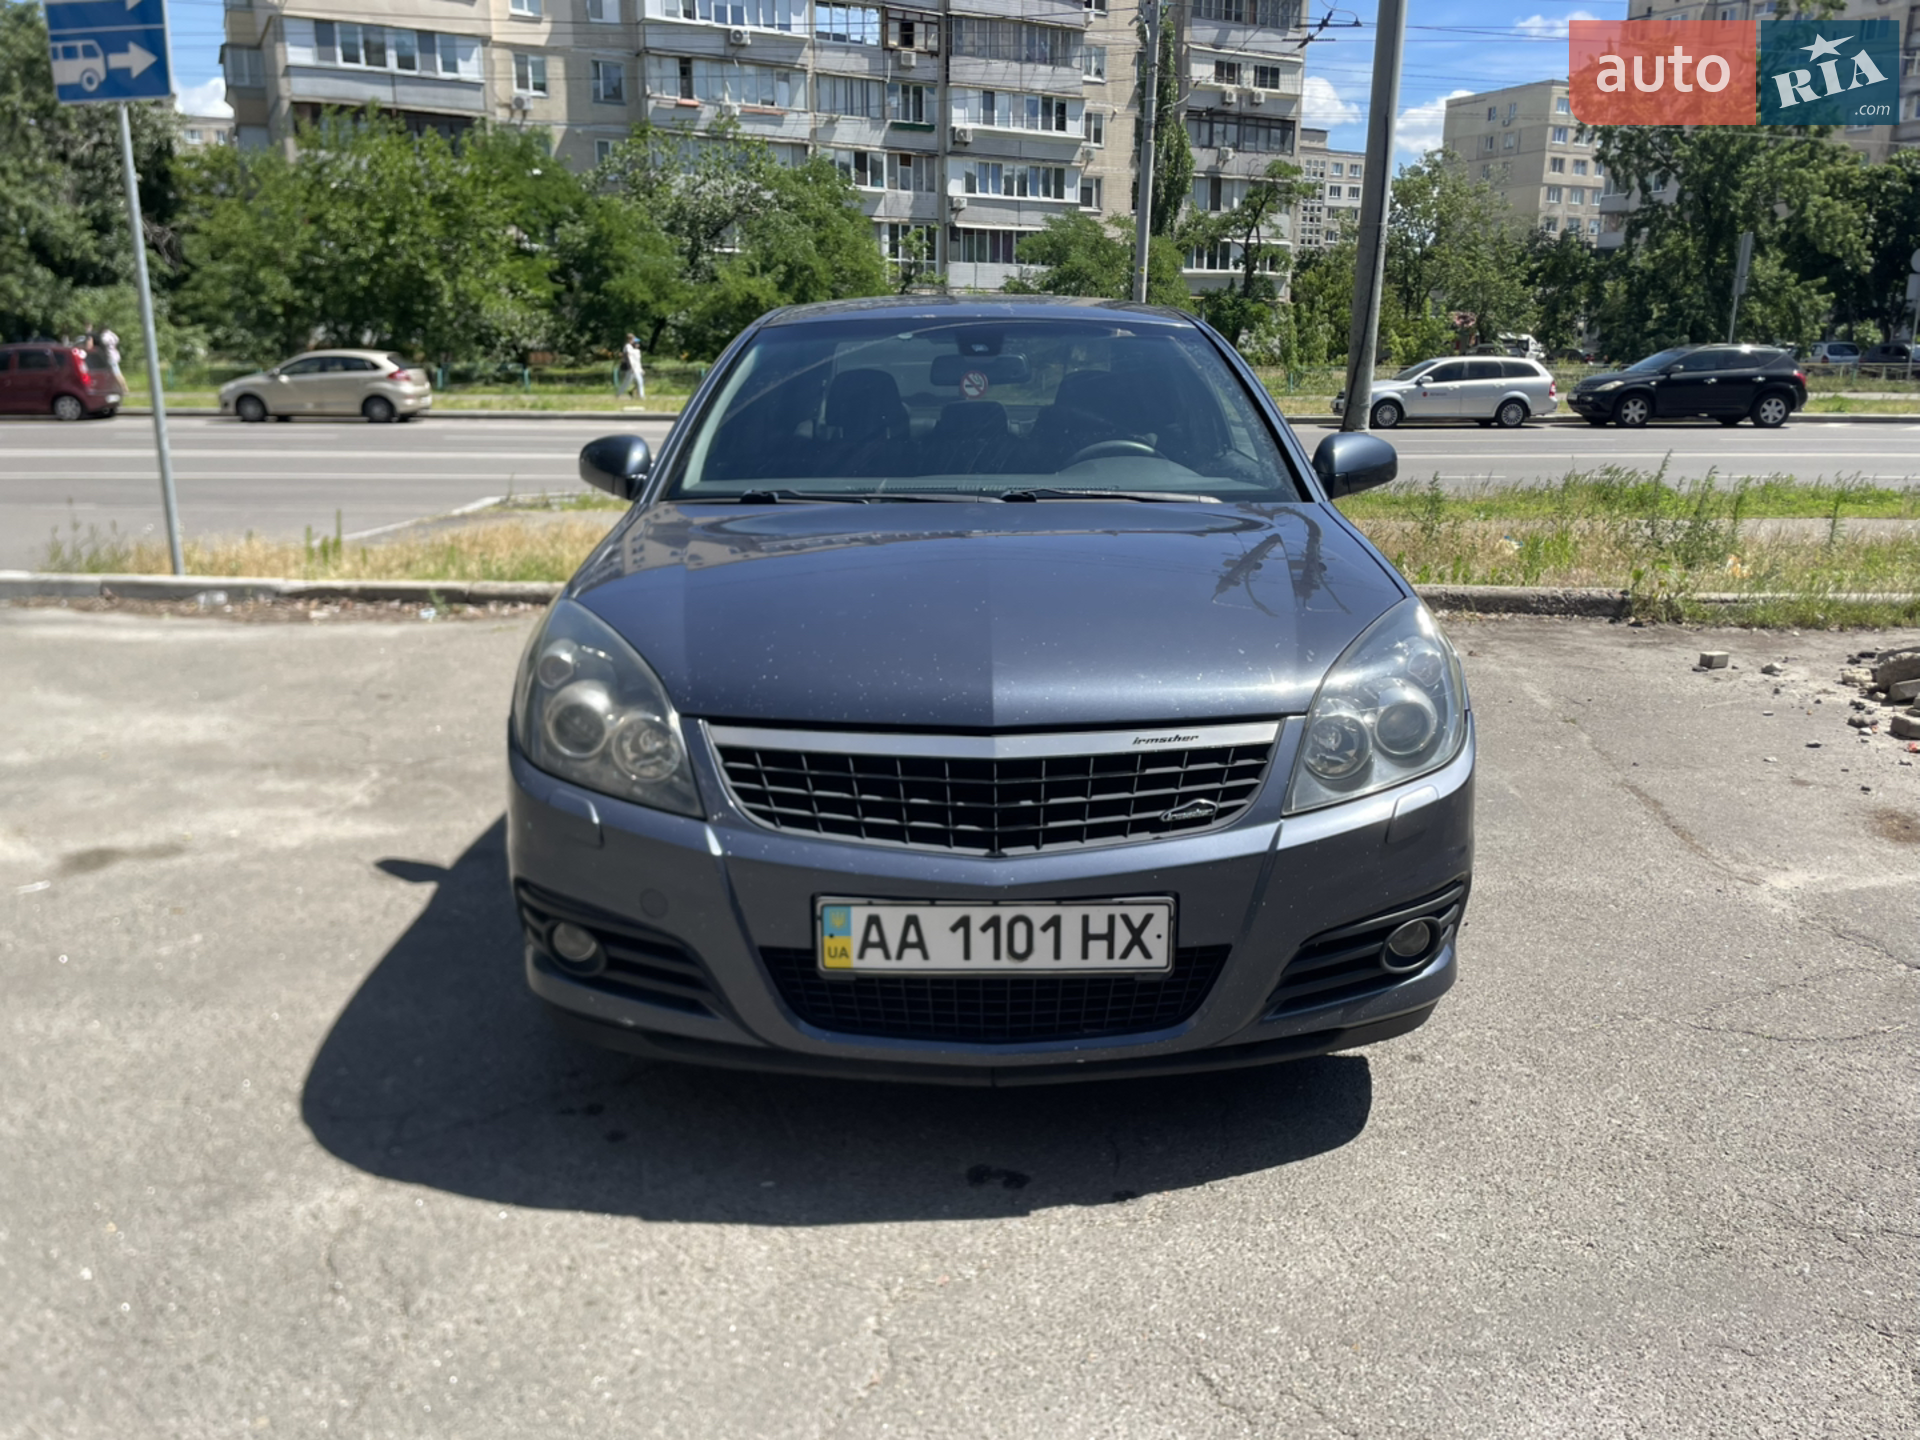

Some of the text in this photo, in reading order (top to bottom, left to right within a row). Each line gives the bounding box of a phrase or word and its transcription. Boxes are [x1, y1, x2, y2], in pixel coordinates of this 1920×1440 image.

[857, 912, 1155, 961] AA 1101 HX
[827, 946, 850, 959] UA
